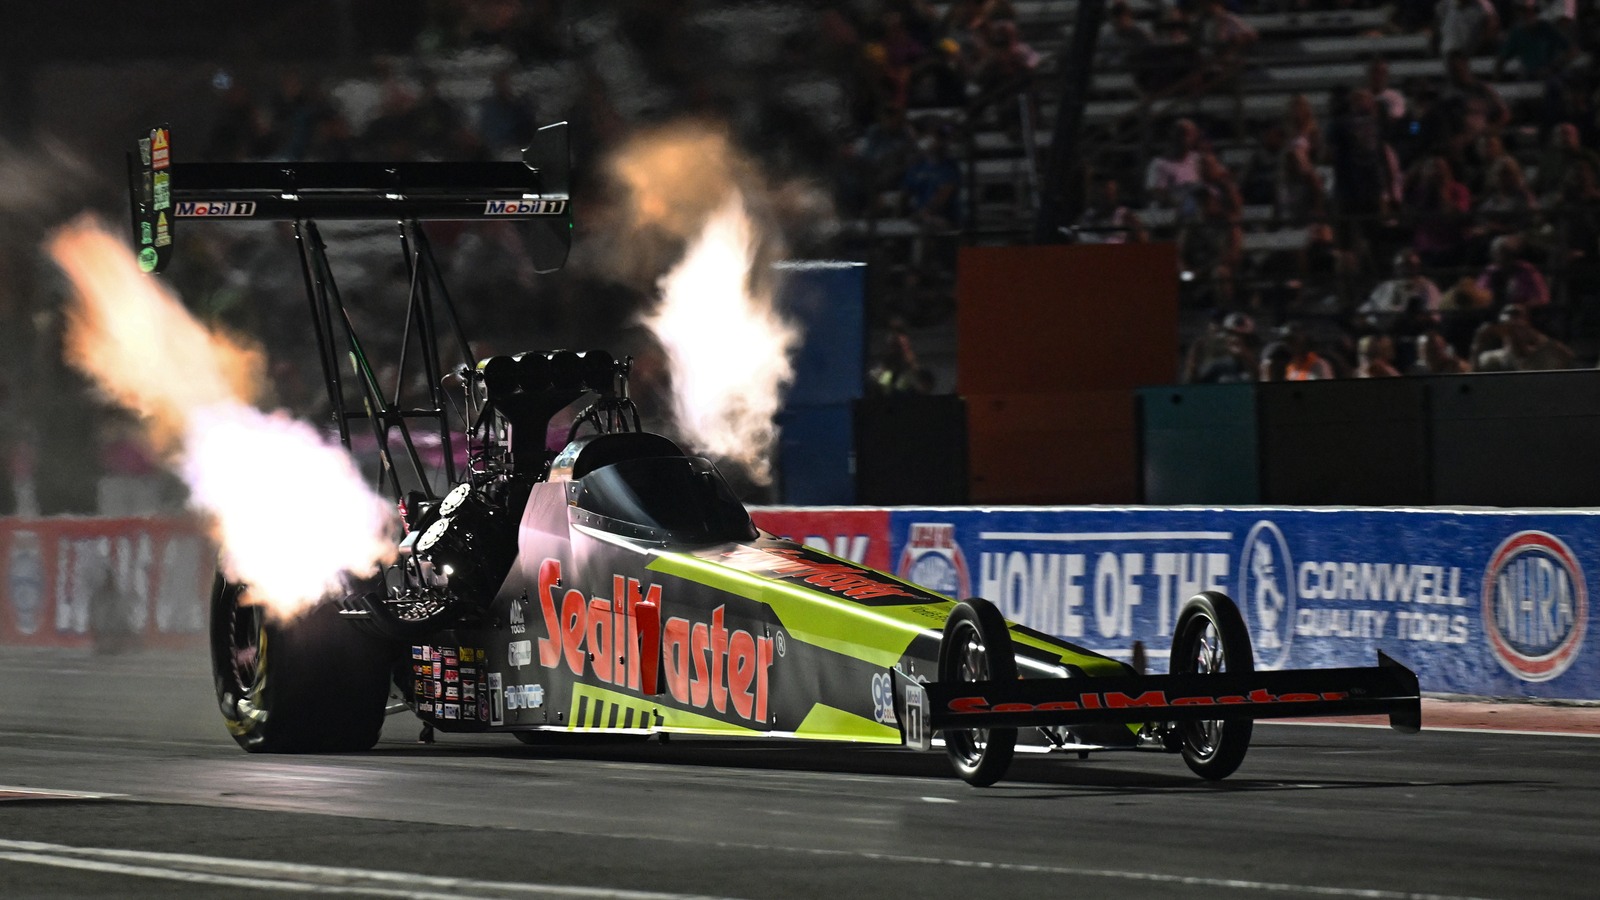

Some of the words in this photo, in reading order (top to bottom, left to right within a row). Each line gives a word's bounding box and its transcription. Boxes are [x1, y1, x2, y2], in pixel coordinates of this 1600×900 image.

[177, 201, 231, 216] Mobil
[487, 200, 542, 214] Mobil
[979, 550, 1086, 639] HOME
[1094, 551, 1148, 639] OF
[1152, 551, 1231, 638] THE
[1297, 560, 1467, 606] CORNWELL
[1496, 556, 1576, 647] NHRA
[537, 557, 775, 724] SealMaster
[1297, 608, 1390, 639] QUALITY
[1395, 610, 1469, 645] TOOLS
[906, 689, 922, 705] Mobil
[947, 687, 1349, 714] SealMaster
